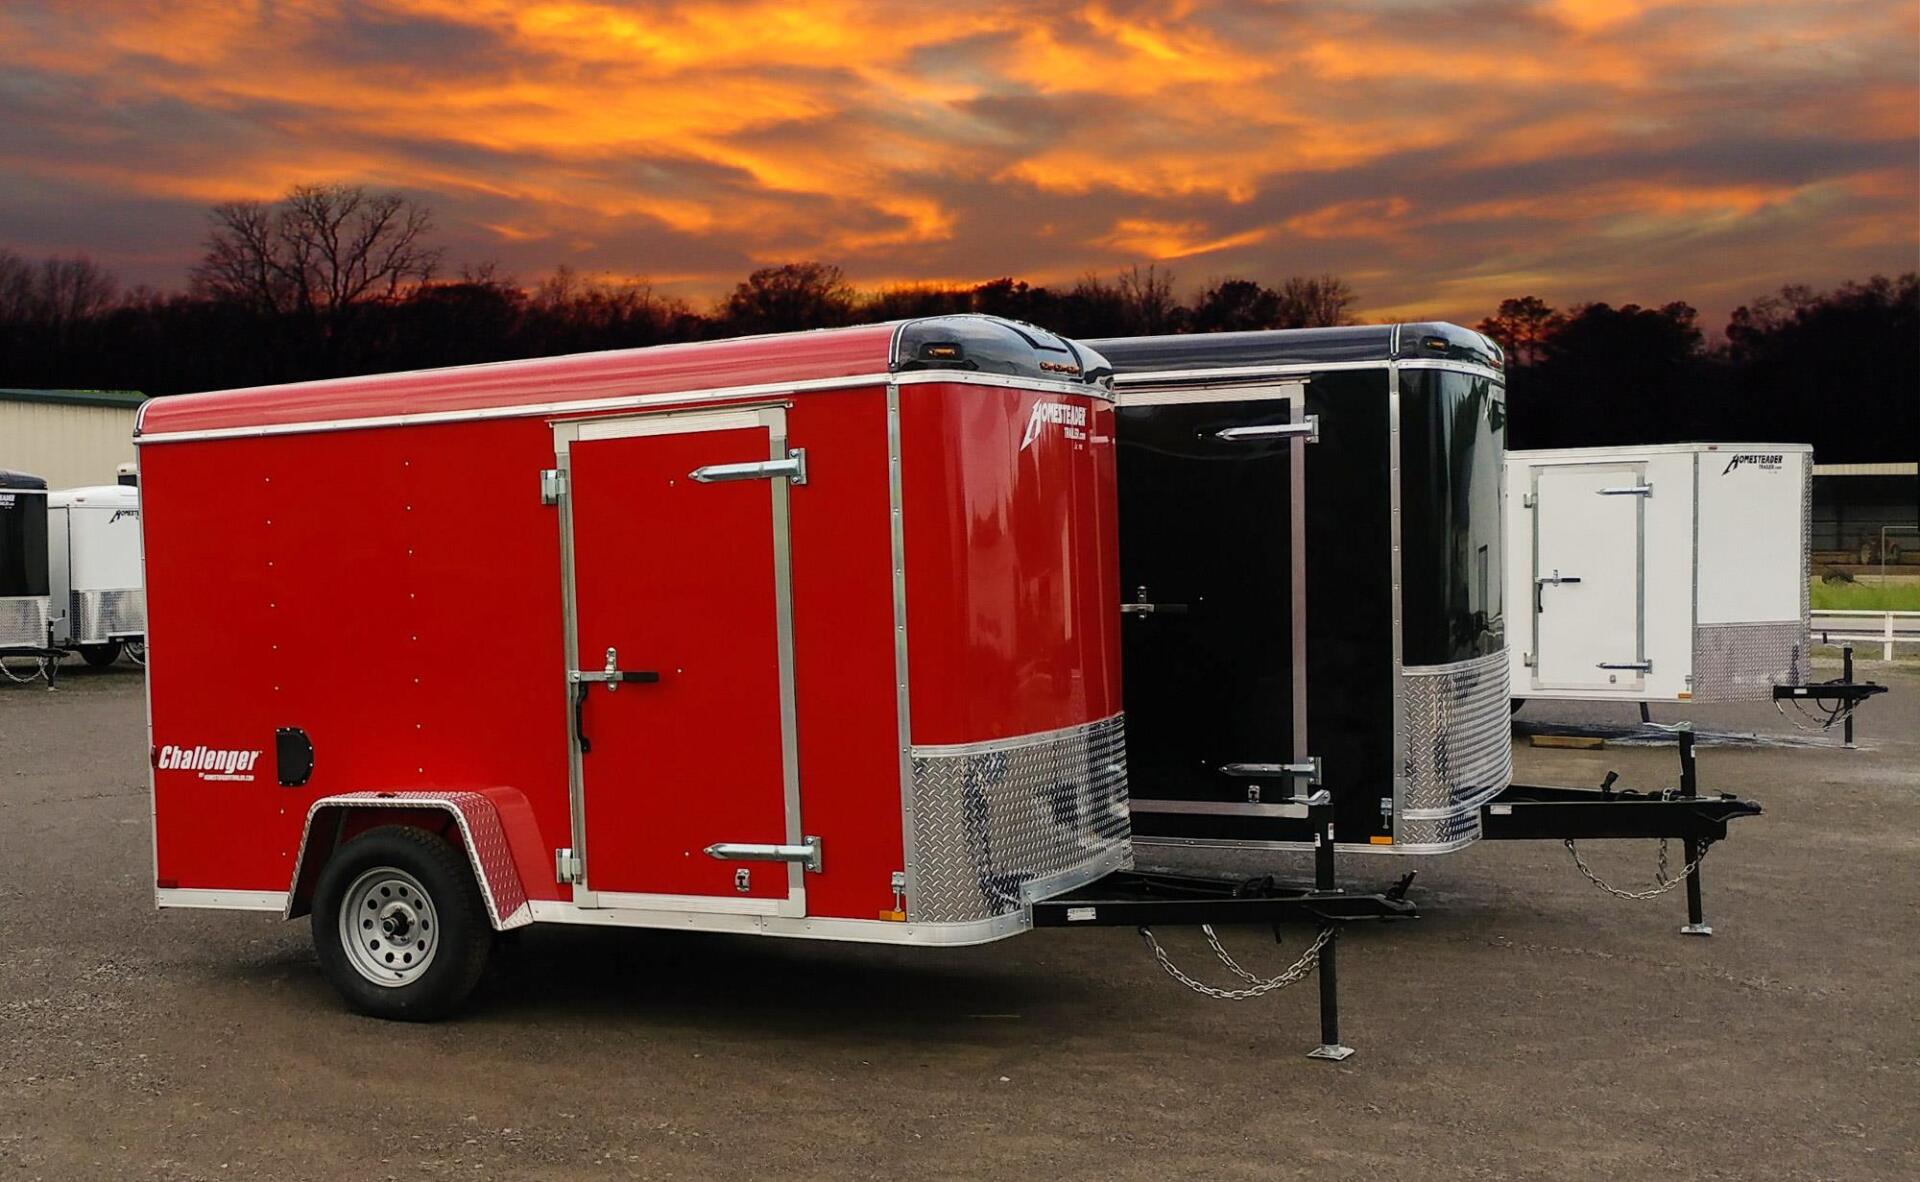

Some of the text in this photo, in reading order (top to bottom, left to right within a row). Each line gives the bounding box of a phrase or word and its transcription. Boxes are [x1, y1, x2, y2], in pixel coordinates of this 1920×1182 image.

[1020, 398, 1087, 451] HOMESTEADER
[1721, 454, 1783, 476] HOMESTEADER
[158, 745, 259, 774] Challenger
